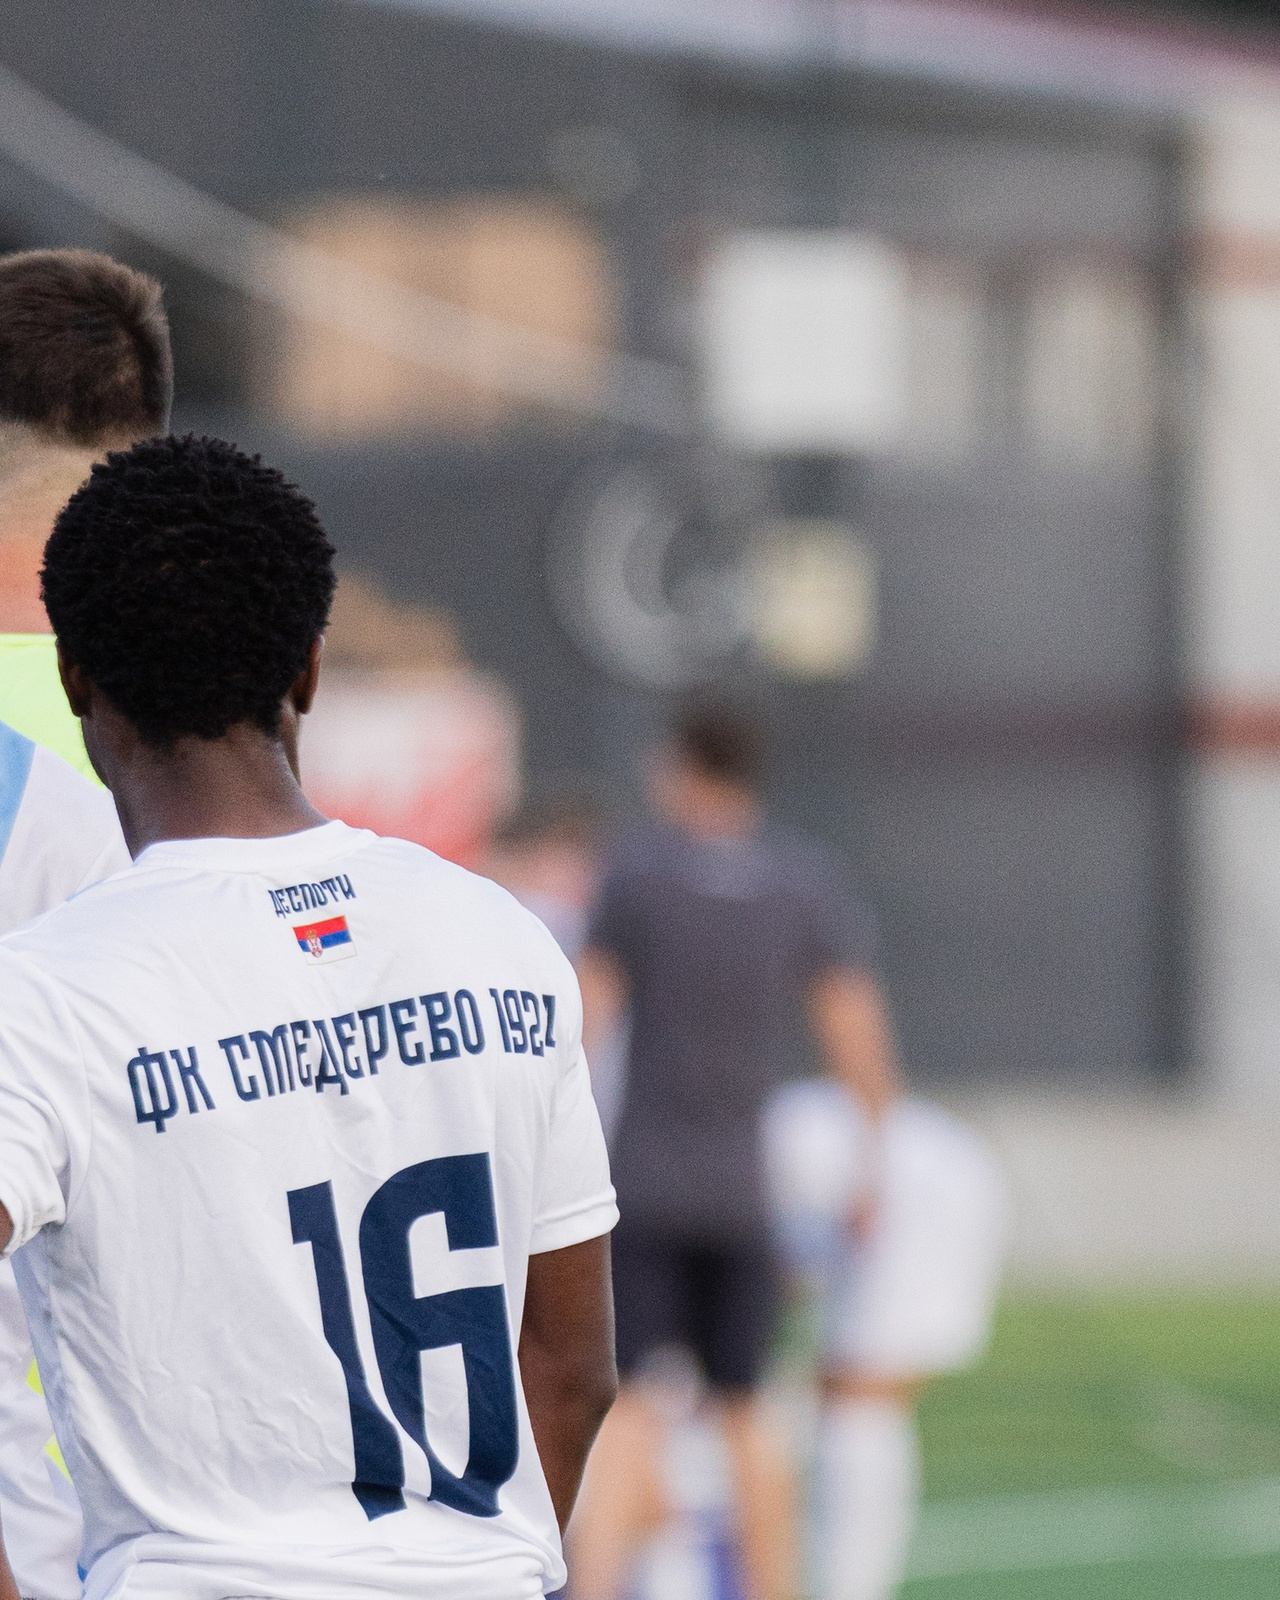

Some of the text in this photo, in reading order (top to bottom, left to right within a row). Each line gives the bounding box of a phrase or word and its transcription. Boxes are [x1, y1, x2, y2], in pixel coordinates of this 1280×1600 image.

[267, 874, 357, 919] ДЕСПОТИ
[126, 1045, 216, 1133] ФК
[218, 988, 486, 1102] СМЕДЕРЕВО
[286, 1151, 520, 1522] 16
